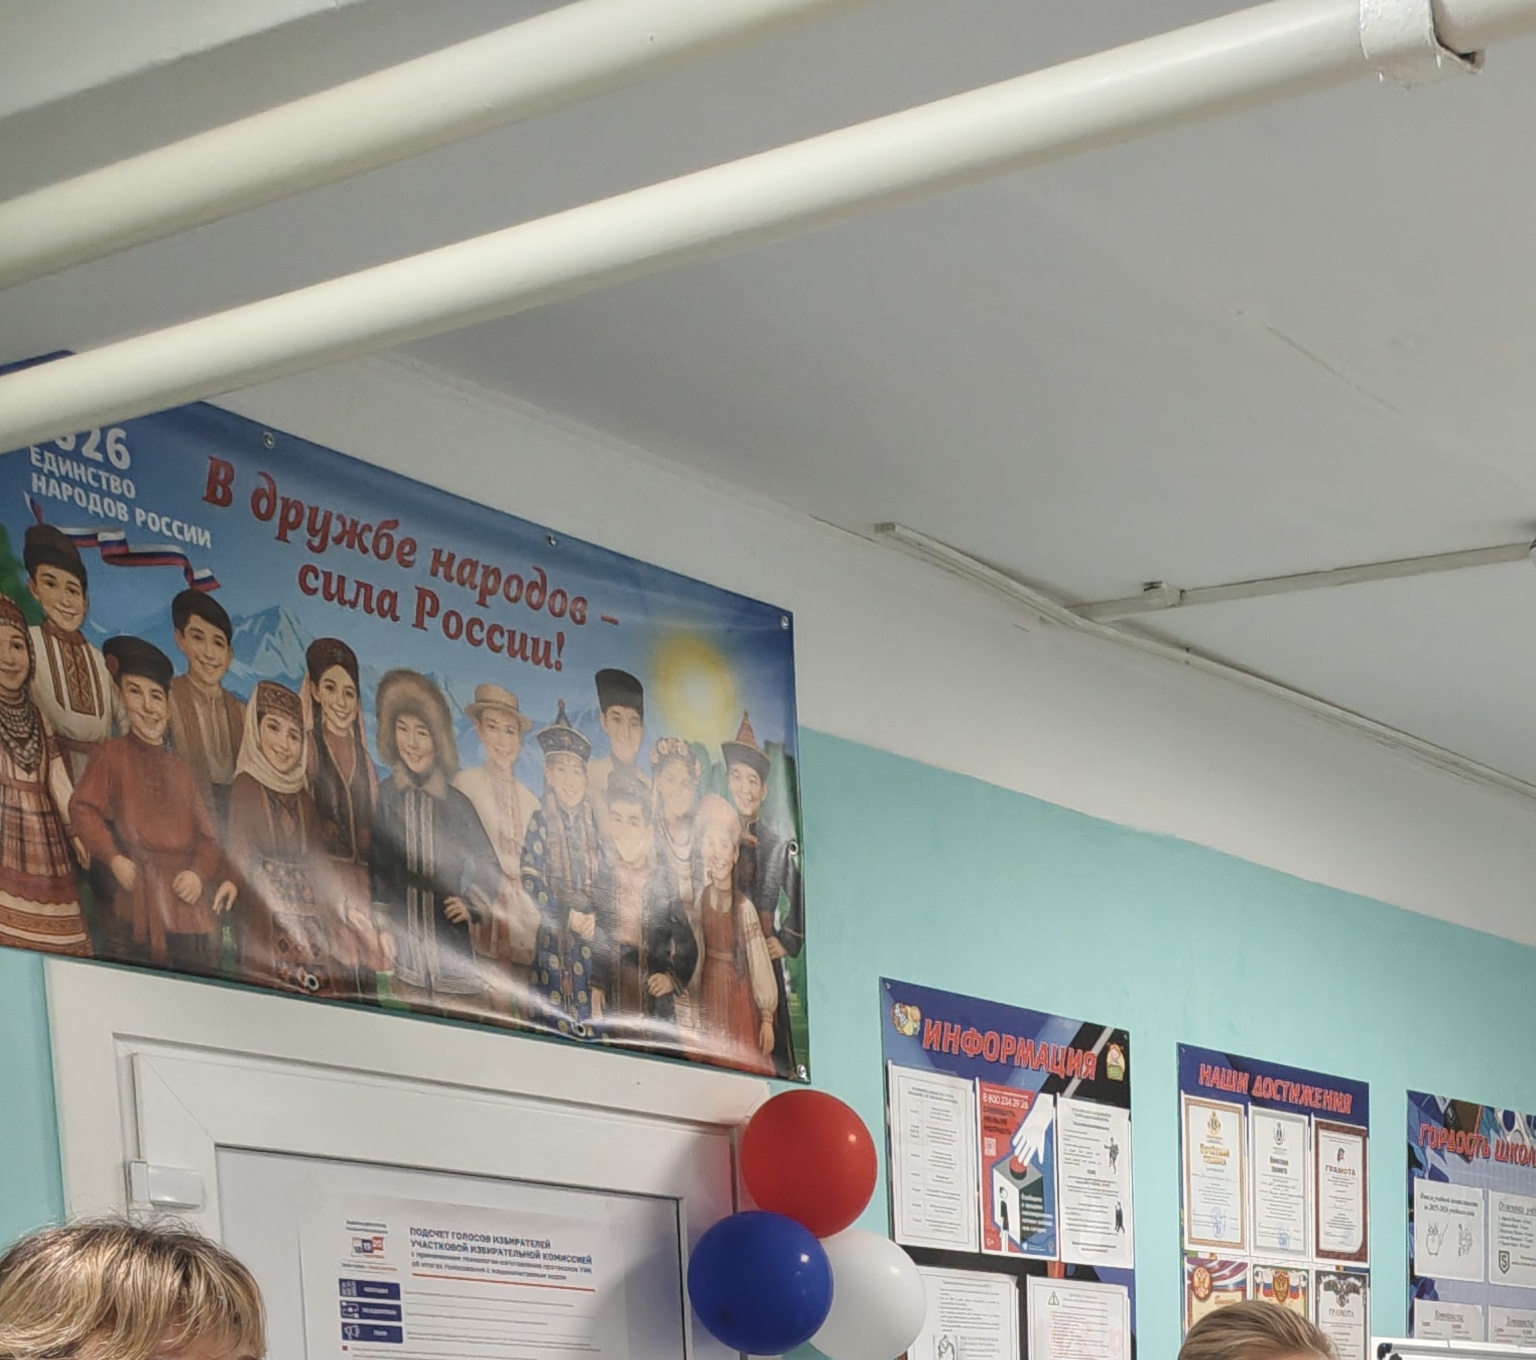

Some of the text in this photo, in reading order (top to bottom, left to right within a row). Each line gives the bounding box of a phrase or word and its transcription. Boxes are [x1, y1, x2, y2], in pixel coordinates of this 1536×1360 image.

[30, 447, 136, 499] ЕДИНСТВО
[31, 472, 212, 549] НАРОДОВ РОССИИ
[202, 456, 235, 507] В
[250, 471, 417, 568] дружбе
[430, 546, 588, 626] народов
[298, 564, 566, 671] сила России!
[922, 1018, 1098, 1080] ИНФОРМАЦИЯ
[1199, 1063, 1353, 1114] НАШИ ДОСТИЖЕНИЯ
[1419, 1123, 1490, 1161] ГОРДОСТЬ
